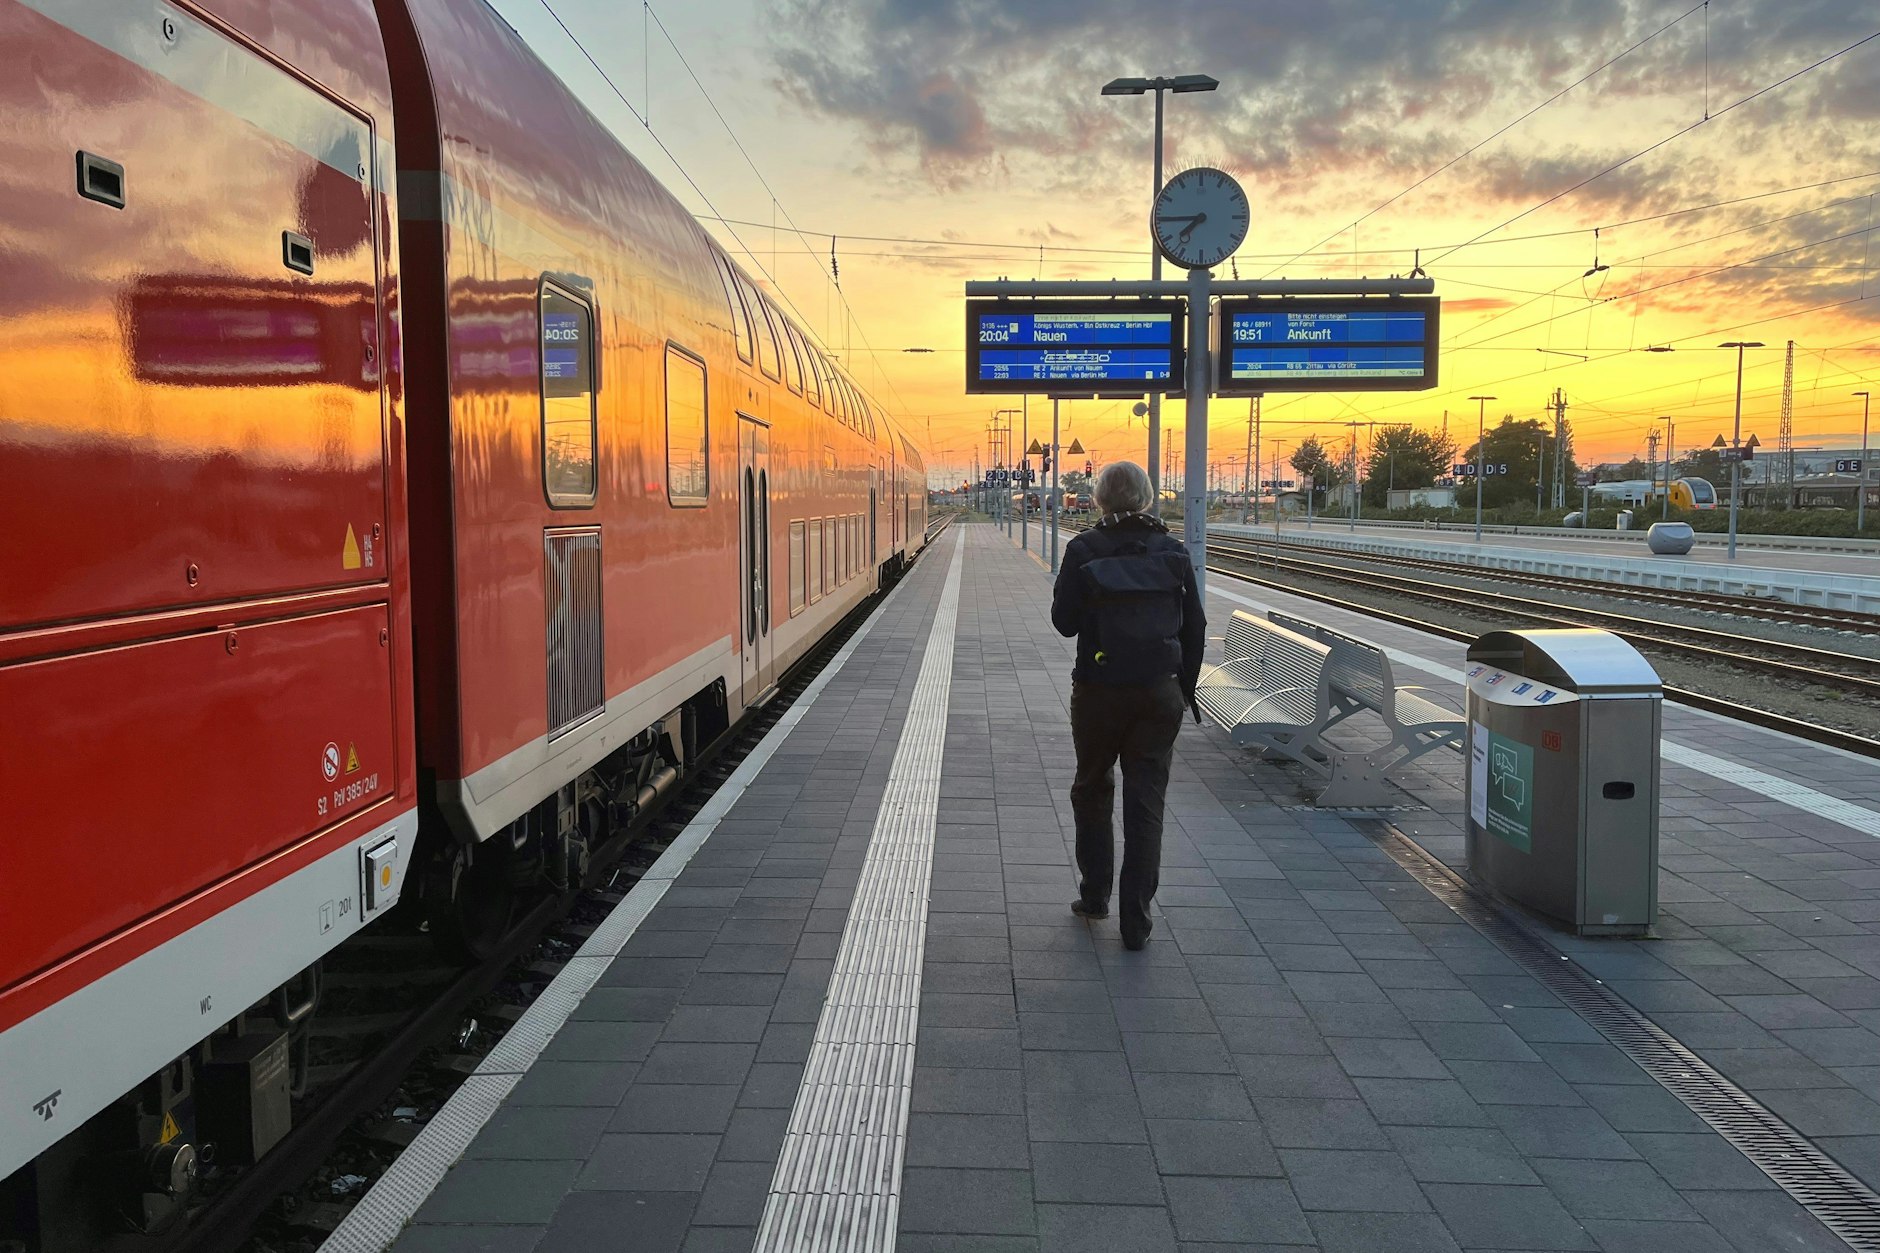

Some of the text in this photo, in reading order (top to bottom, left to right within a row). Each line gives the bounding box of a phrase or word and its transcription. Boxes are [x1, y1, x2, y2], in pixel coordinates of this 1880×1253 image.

[1034, 321, 1052, 330] Königs
[1126, 321, 1142, 329] Berlin
[979, 330, 1009, 342] 20:04
[1034, 330, 1068, 342] Nauen
[1233, 329, 1262, 341] 19:51
[1287, 328, 1332, 340] Ankunft
[1454, 464, 1475, 474] 4 D
[1486, 463, 1507, 474] D 5
[1837, 460, 1858, 471] 6 E
[986, 470, 1006, 480] 2 D
[1028, 470, 1034, 480] 3
[1543, 731, 1561, 752] DB
[317, 796, 328, 816] S2
[199, 995, 212, 1015] WC
